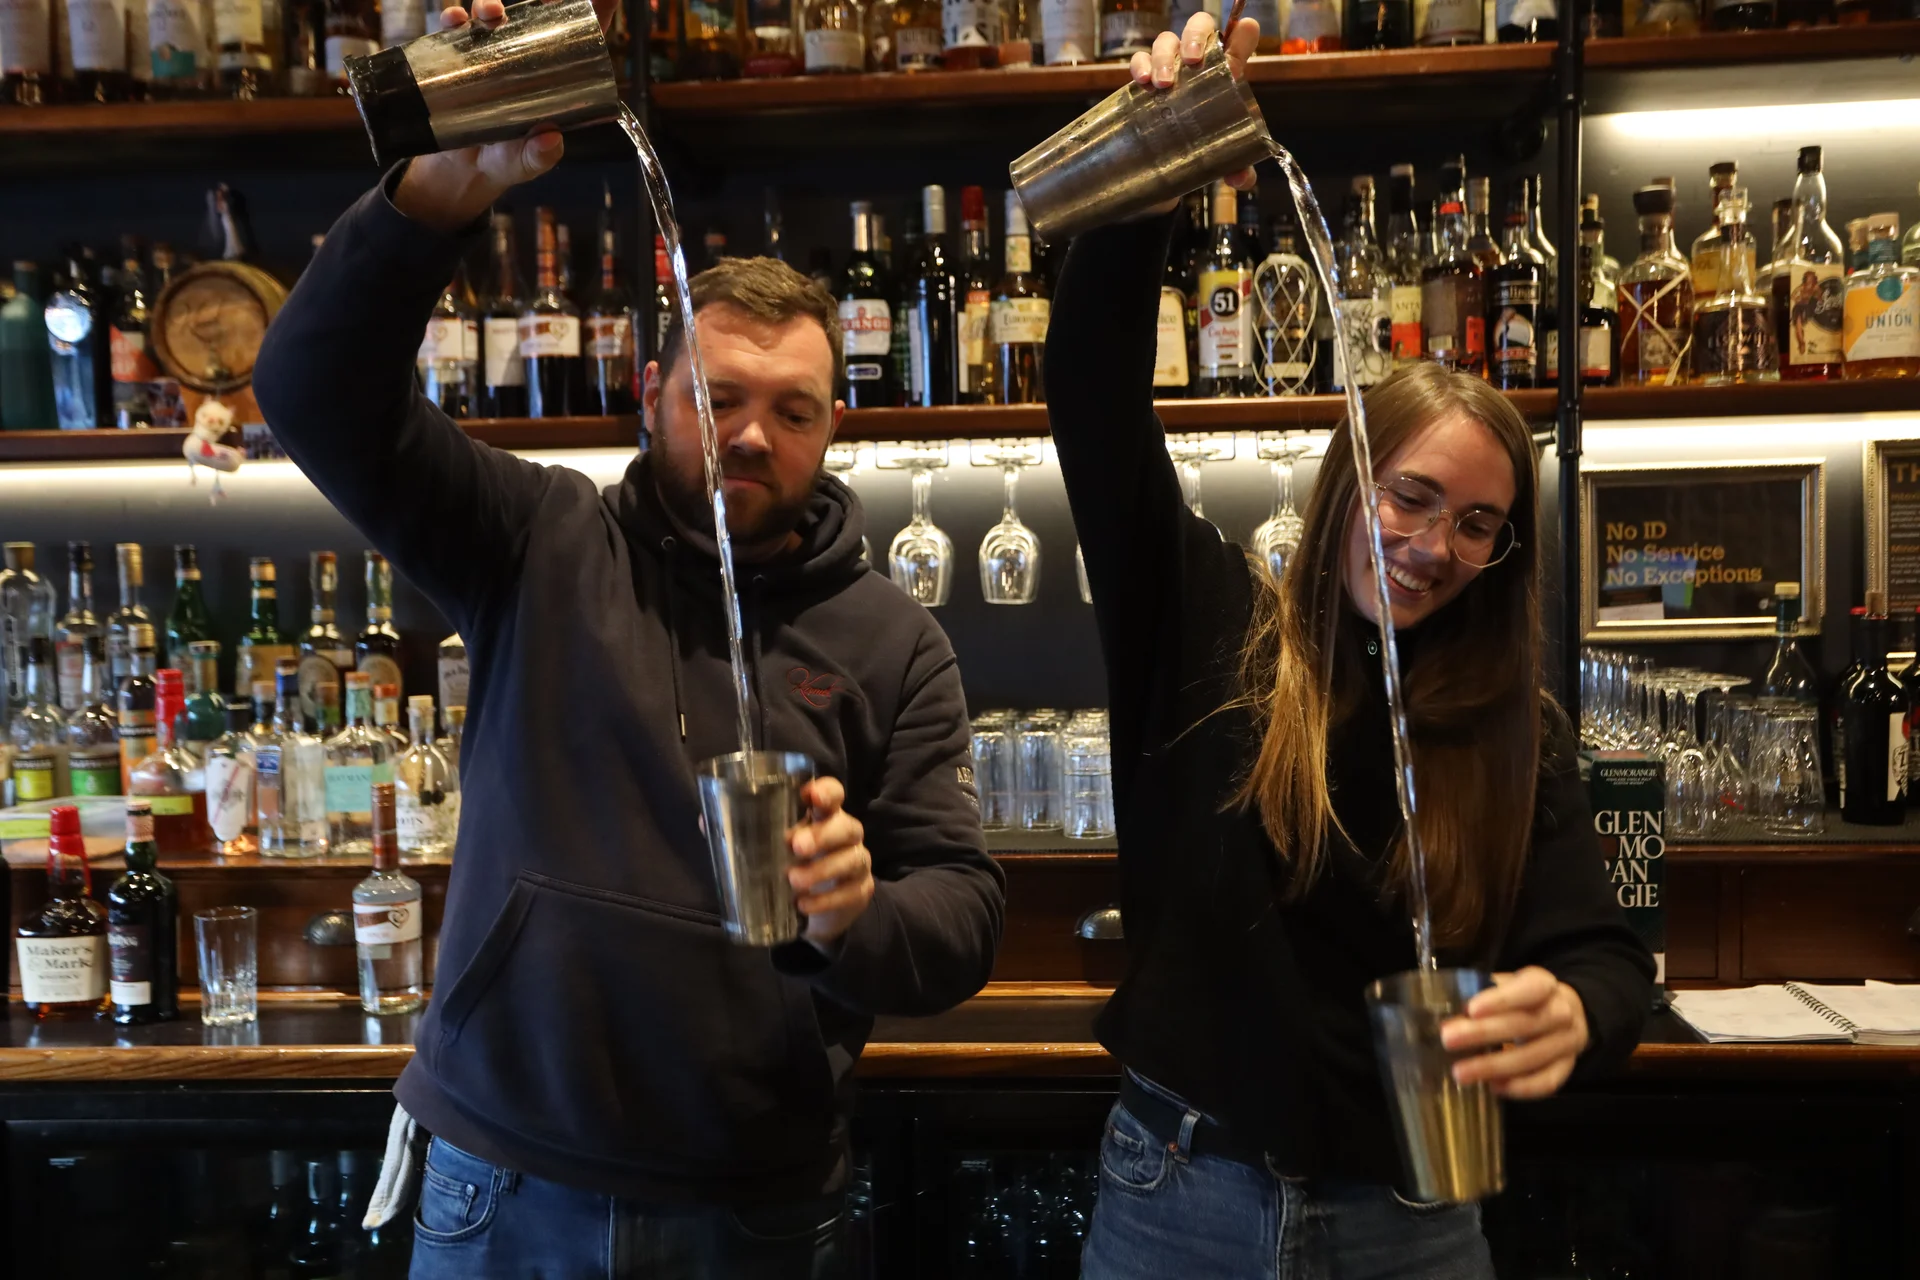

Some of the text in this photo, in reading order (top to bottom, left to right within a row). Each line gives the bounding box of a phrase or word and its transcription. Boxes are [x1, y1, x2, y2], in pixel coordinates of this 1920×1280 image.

[1213, 292, 1236, 313] 51
[1865, 313, 1912, 329] UNION
[1605, 521, 1667, 541] No ID
[1606, 542, 1726, 564] No Service
[1605, 564, 1763, 588] No Exceptions
[1594, 810, 1663, 835] GLEN
[1618, 835, 1666, 860] MO
[1604, 860, 1649, 884] AN
[1616, 884, 1660, 908] GIE
[25, 944, 94, 957] Maker's
[44, 957, 93, 970] Mark
